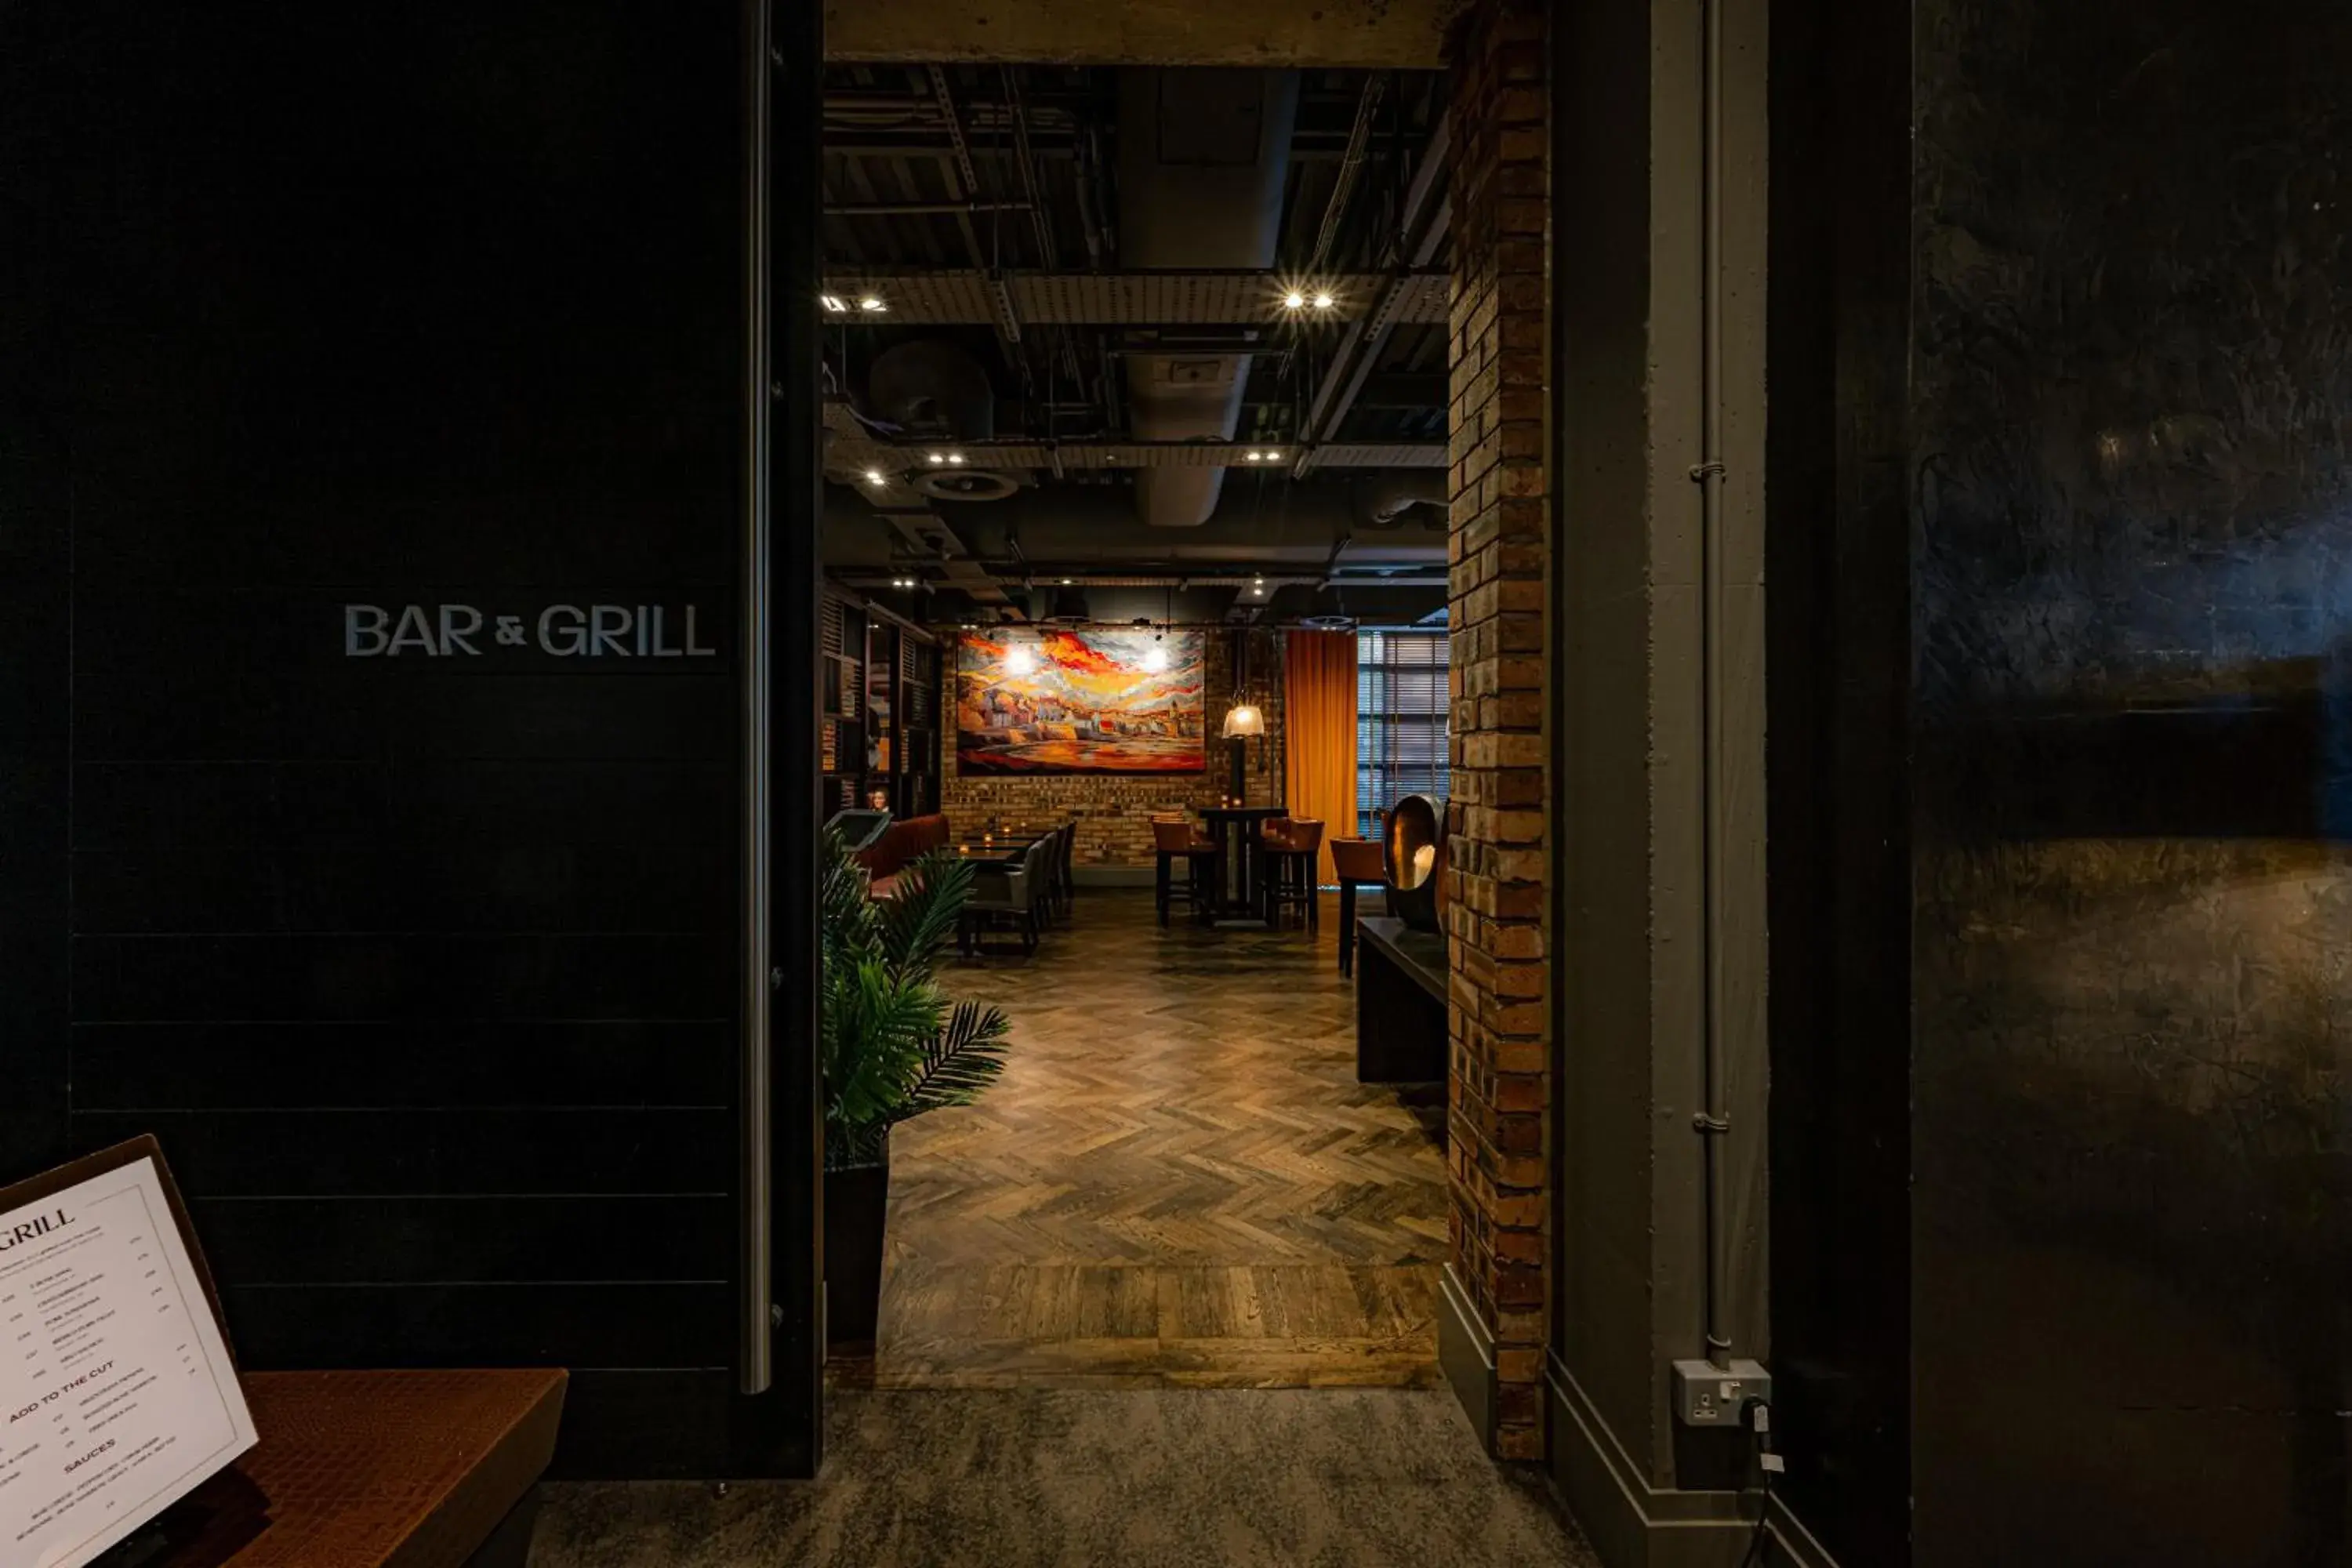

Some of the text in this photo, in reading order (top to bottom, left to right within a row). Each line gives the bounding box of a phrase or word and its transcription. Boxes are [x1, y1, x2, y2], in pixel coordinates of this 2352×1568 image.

[345, 604, 716, 656] BAR & GRILL
[9, 1403, 39, 1424] ADD
[41, 1392, 60, 1404] TO
[62, 1375, 88, 1392] THE
[89, 1360, 114, 1377] CUT
[64, 1438, 116, 1474] SAUCES
